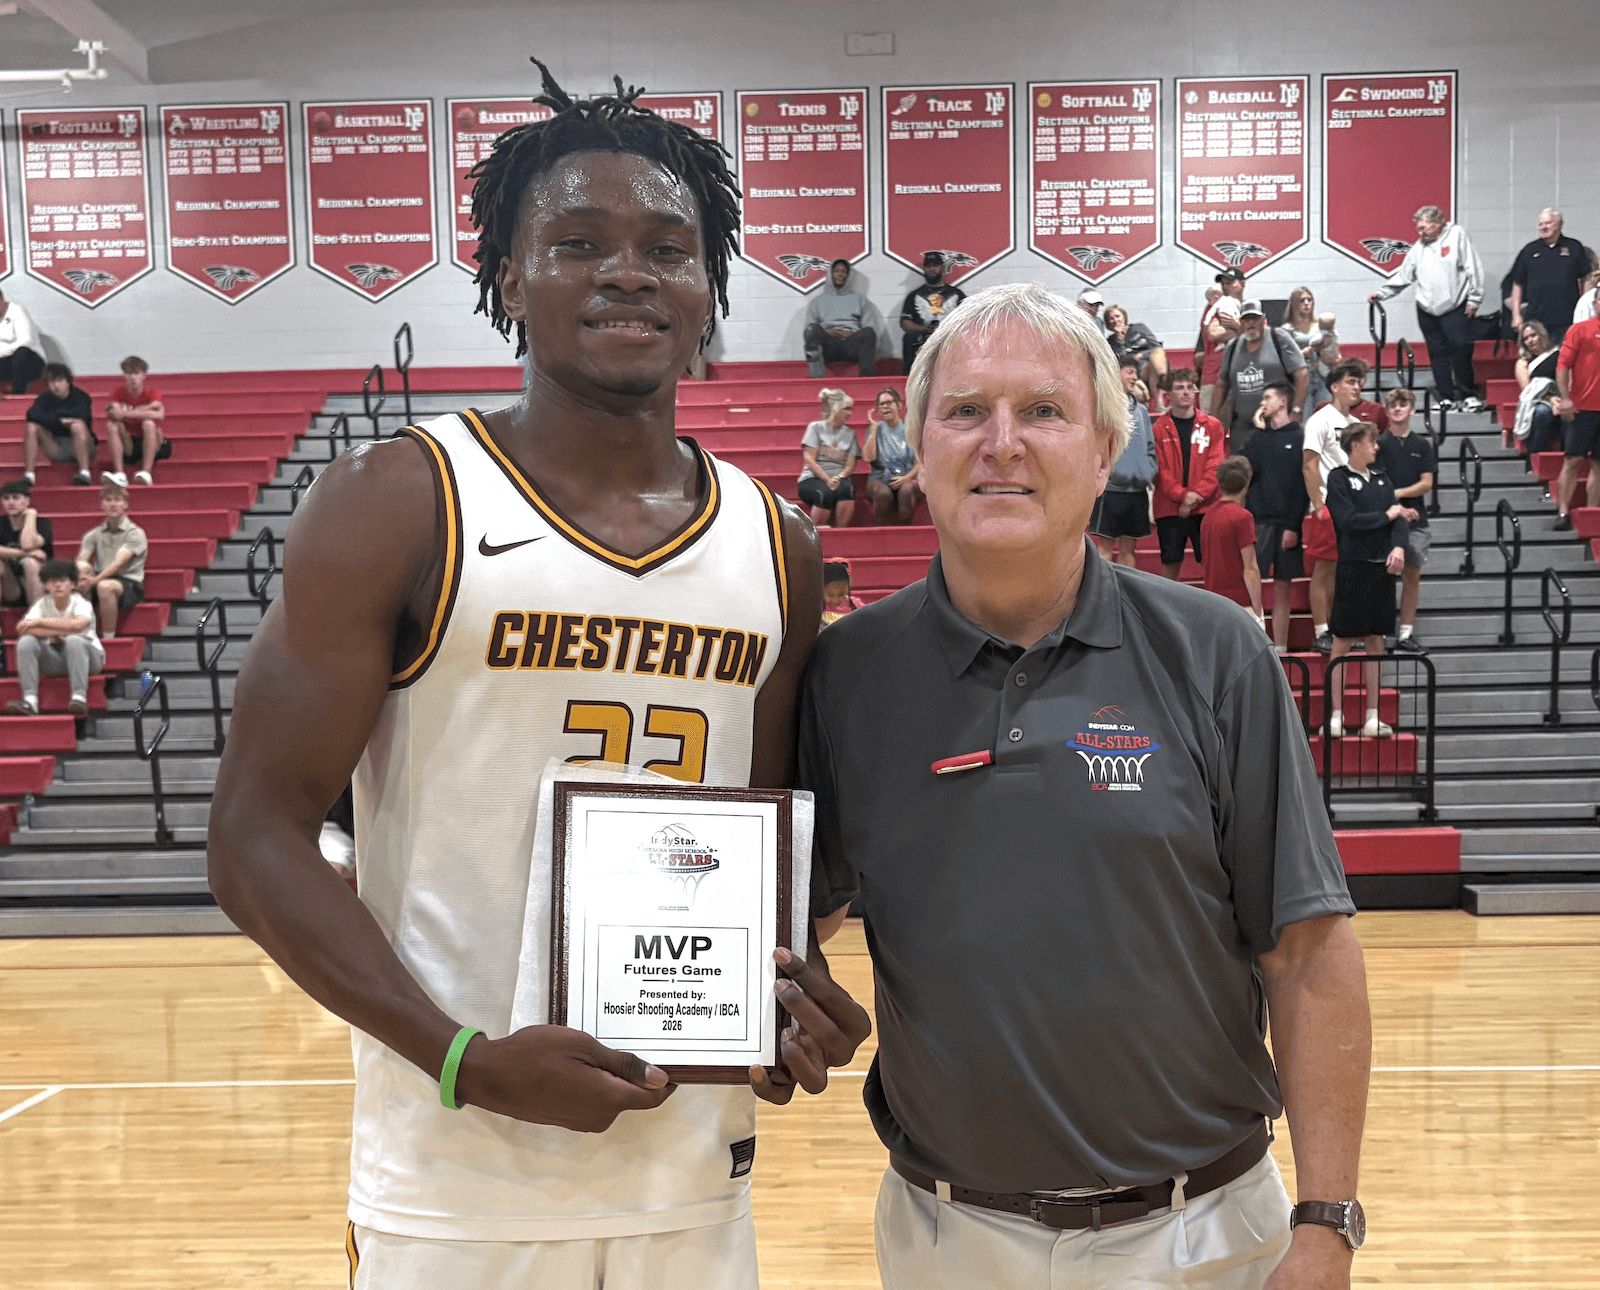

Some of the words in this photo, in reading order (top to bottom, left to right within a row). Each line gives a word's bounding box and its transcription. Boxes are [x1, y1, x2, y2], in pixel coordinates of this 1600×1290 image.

[1208, 90, 1276, 104] BASEBALL
[1361, 88, 1425, 100] SWIMMING
[927, 99, 972, 112] TRACK
[1062, 95, 1128, 108] SOFTBALL
[778, 103, 827, 116] TENNIS
[1331, 109, 1386, 119] SECTIONAL
[1387, 107, 1446, 117] CHAMPIONS
[335, 115, 405, 128] BASKETBALL
[1038, 116, 1091, 126] SECTIONAL
[1093, 115, 1151, 124] CHAMPIONS
[1185, 112, 1239, 122] SECTIONAL
[1240, 110, 1298, 120] CHAMPIONS
[50, 121, 113, 134] FOOTBALL
[189, 117, 259, 130] WRESTLING
[746, 124, 799, 134] SECTIONAL
[801, 123, 858, 133] CHAMPIONS
[891, 121, 945, 130] SECTIONAL
[946, 119, 1004, 129] CHAMPIONS
[169, 138, 221, 148] SECTIONAL
[223, 137, 280, 147] CHAMPIONS
[312, 136, 365, 146] SECTIONAL
[367, 134, 424, 144] CHAMPIONS
[27, 142, 80, 152] SECTIONAL
[80, 140, 137, 151] CHAMPIONS
[1041, 180, 1089, 190] REGIONAL
[1091, 179, 1148, 188] CHAMPIONS
[1187, 175, 1236, 185] REGIONAL
[1237, 174, 1295, 184] CHAMPIONS
[749, 188, 797, 198] REGIONAL
[799, 187, 856, 196] CHAMPIONS
[895, 184, 943, 194] REGIONAL
[944, 183, 1002, 192] CHAMPIONS
[175, 201, 222, 211] REGIONAL
[224, 200, 280, 210] CHAMPIONS
[318, 198, 365, 208] REGIONAL
[366, 197, 423, 207] CHAMPIONS
[33, 205, 80, 215] REGIONAL
[82, 203, 138, 213] CHAMPIONS
[1035, 216, 1095, 226] SEMI-STATE
[1097, 215, 1154, 225] CHAMPIONS
[1181, 211, 1242, 222] SEMI-STATE
[1243, 210, 1301, 220] CHAMPIONS
[745, 225, 804, 235] SEMI-STATE
[806, 224, 863, 233] CHAMPIONS
[172, 237, 229, 247] SEMI-STATE
[232, 236, 287, 245] CHAMPIONS
[314, 234, 372, 244] SEMI-STATE
[374, 233, 430, 242] CHAMPIONS
[30, 240, 88, 250] SEMI-STATE
[90, 239, 145, 249] CHAMPIONS
[484, 610, 769, 688] CHESTERTON
[1076, 733, 1151, 749] ALL-STARS
[634, 935, 712, 960] MVP
[624, 965, 677, 975] Futures
[682, 966, 722, 976] Game
[640, 990, 688, 999] Presented
[691, 990, 706, 1000] by:
[604, 1002, 636, 1015] Hoosier
[637, 1003, 674, 1017] Shooting
[676, 1004, 713, 1018] Academy
[720, 1004, 740, 1016] IBCA
[662, 1020, 682, 1031] 2026
